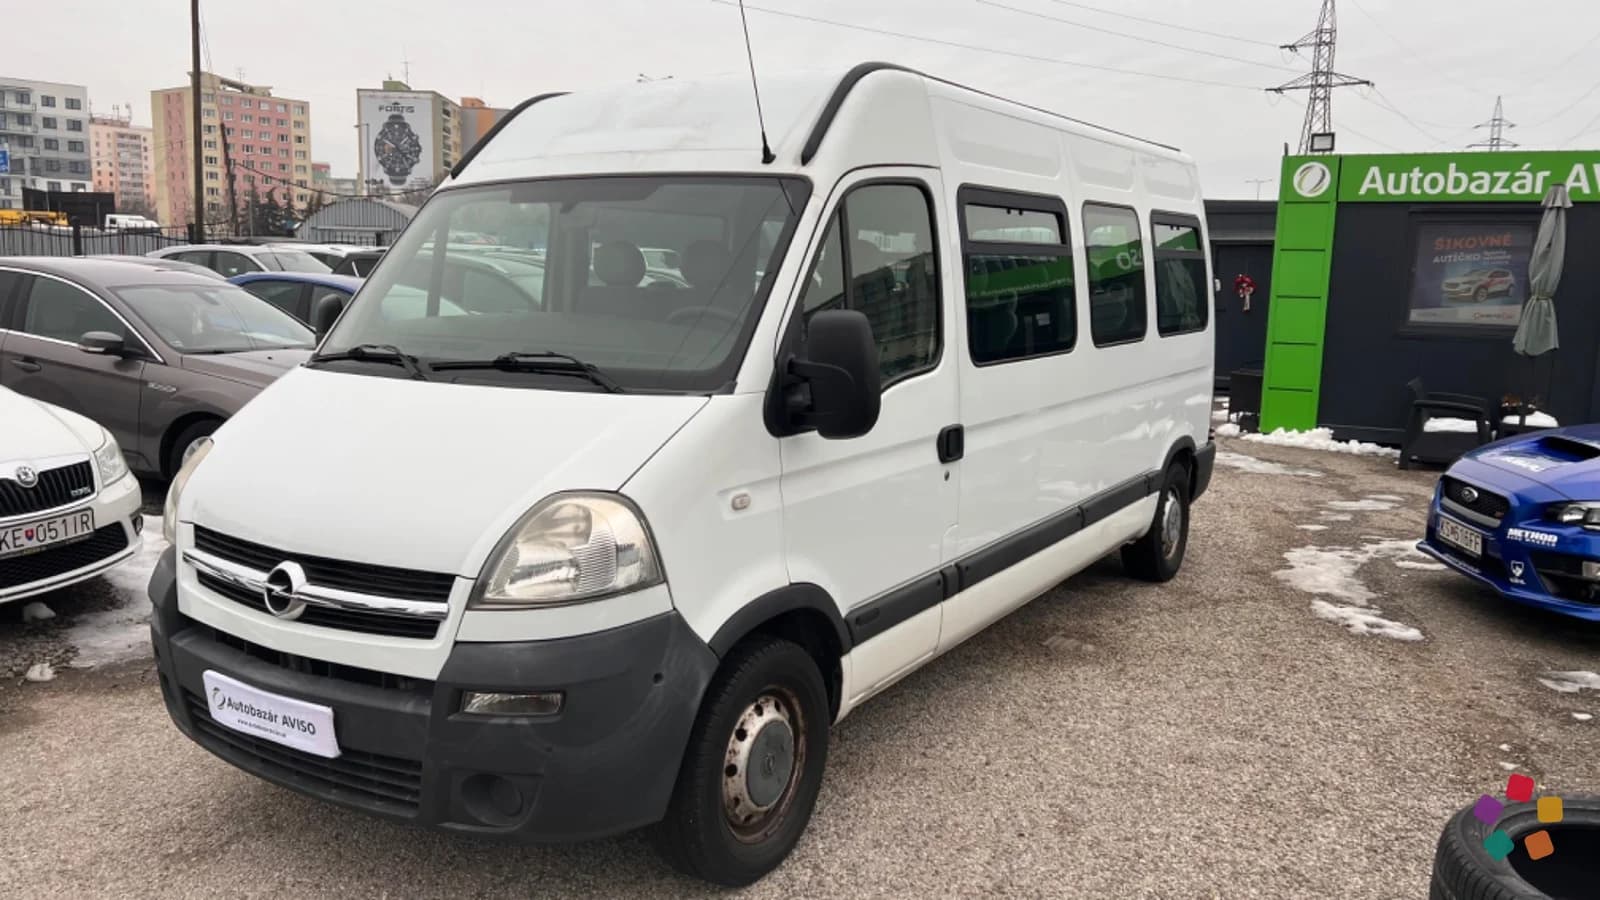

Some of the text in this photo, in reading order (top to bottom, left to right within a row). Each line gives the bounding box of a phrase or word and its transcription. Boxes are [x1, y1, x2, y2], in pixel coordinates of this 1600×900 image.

[378, 105, 415, 113] FORTIS
[1358, 162, 1551, 195] Autobazár
[227, 697, 278, 723] Autobazár
[282, 714, 316, 735] AVISO
